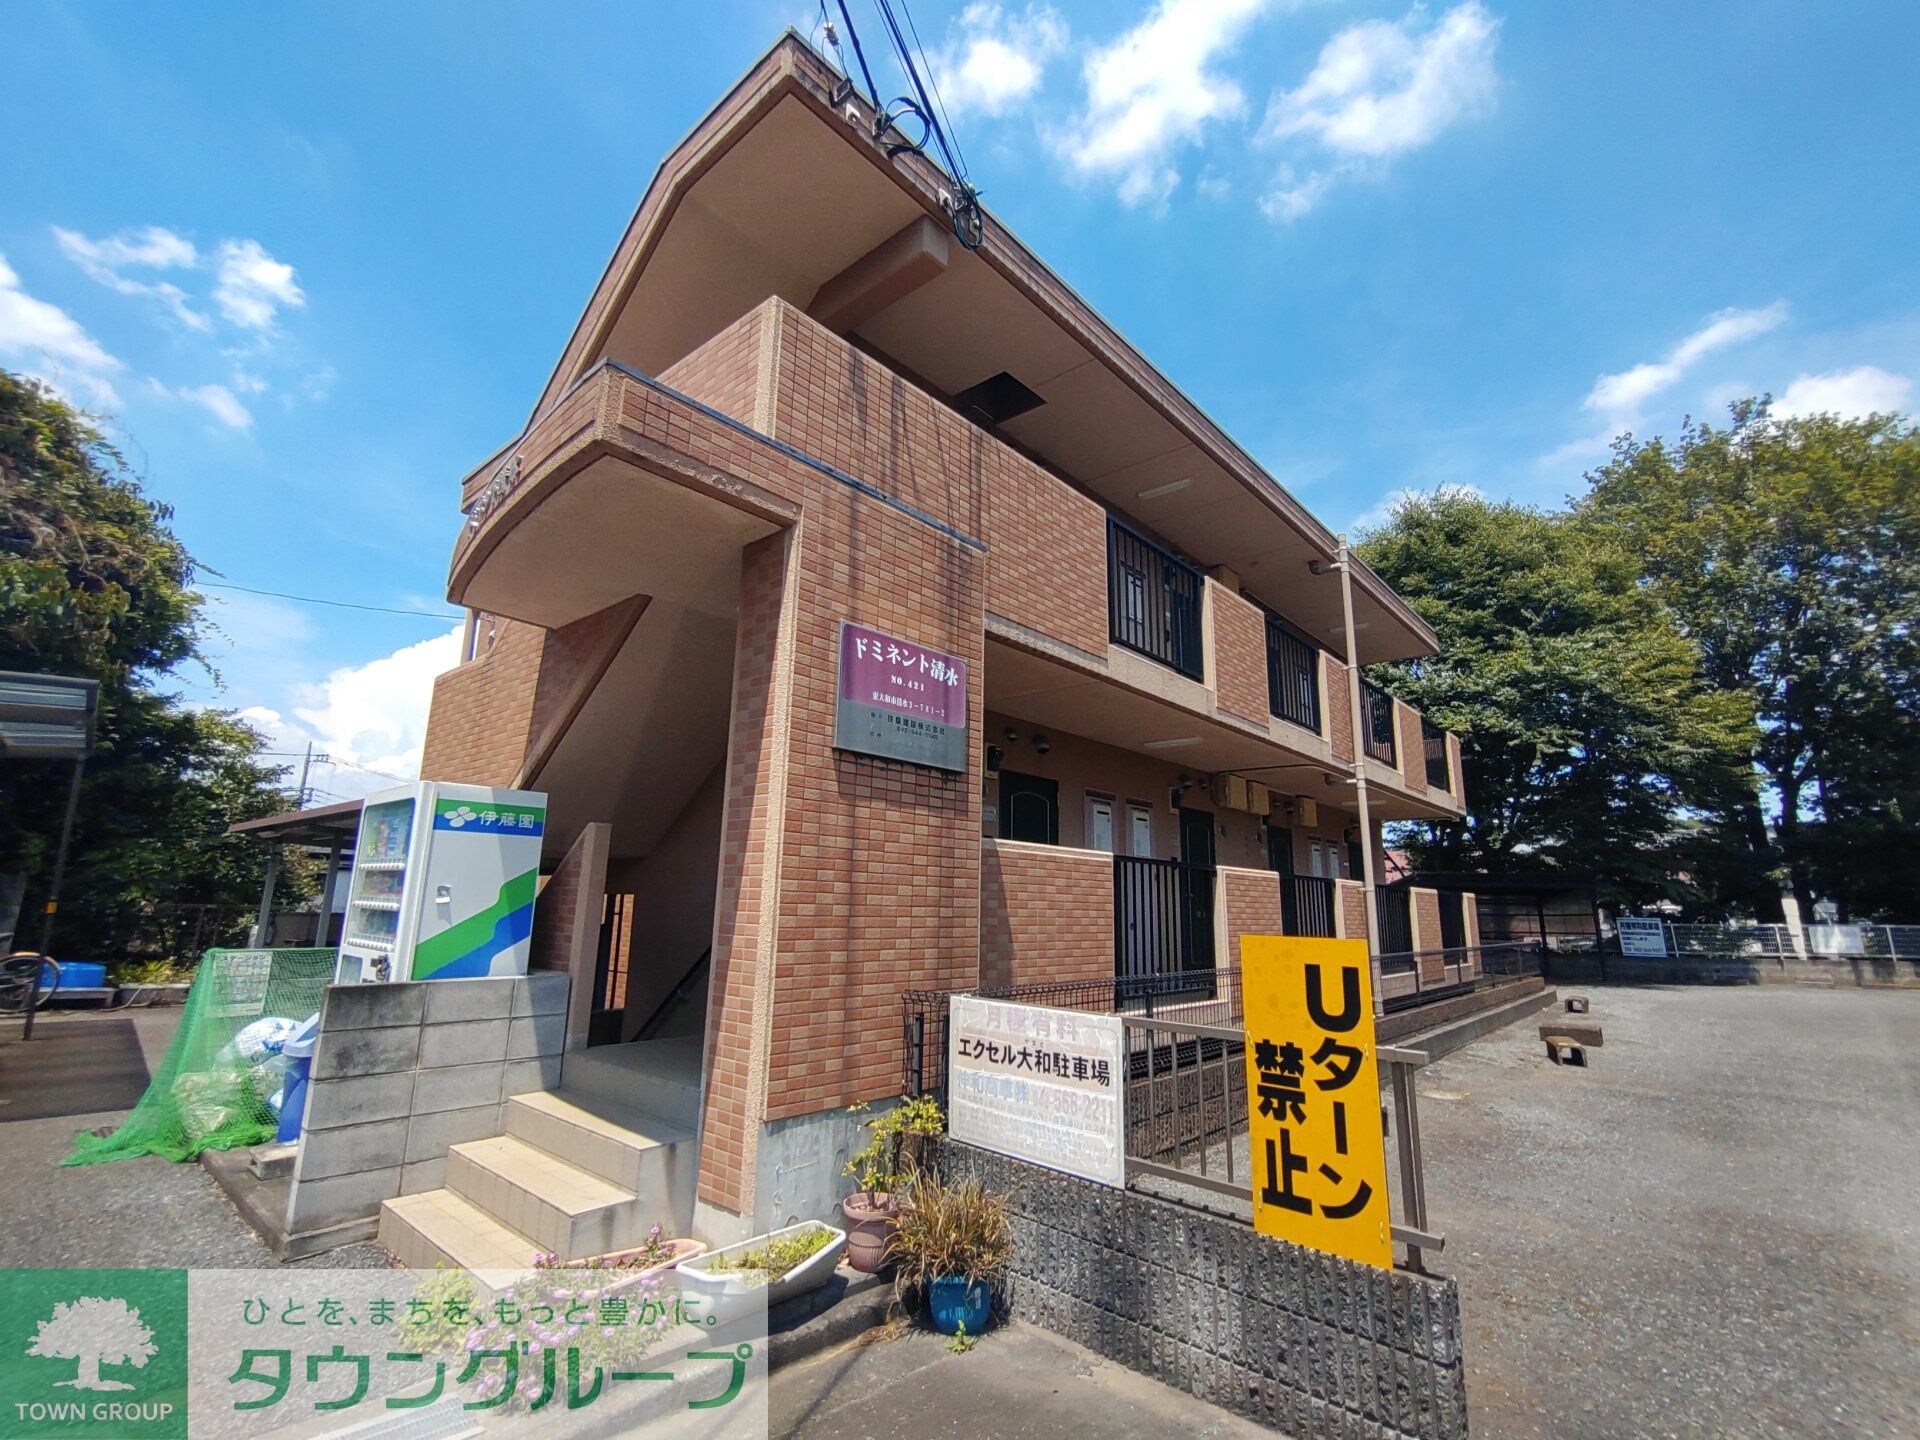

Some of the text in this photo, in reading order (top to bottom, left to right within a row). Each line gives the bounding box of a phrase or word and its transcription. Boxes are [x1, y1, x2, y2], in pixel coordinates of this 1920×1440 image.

[855, 637, 959, 686] ドミネント清水
[890, 675, 924, 691] NO.421
[479, 809, 535, 829] 伊藤園
[957, 1038, 1111, 1088] エクセル大和駐車場
[1304, 963, 1373, 1220] Uターン
[1254, 1039, 1313, 1216] 禁止
